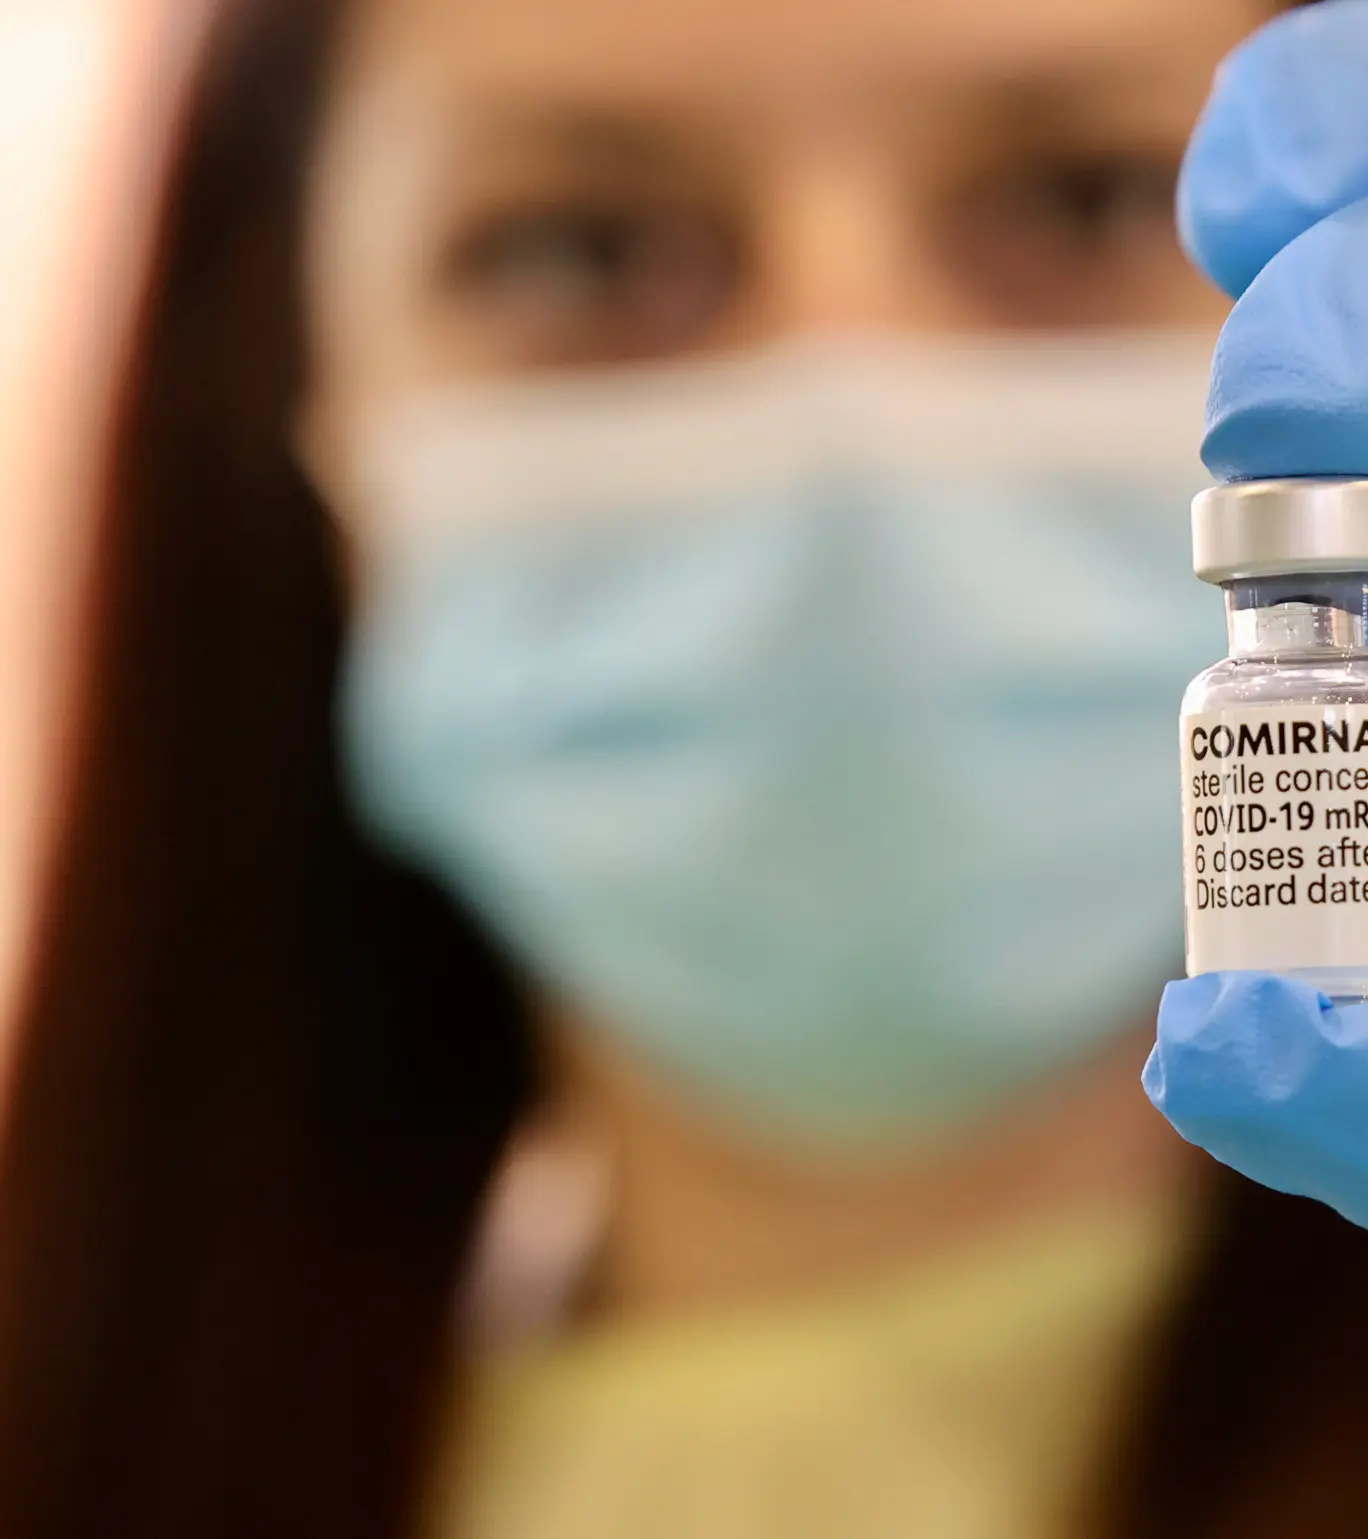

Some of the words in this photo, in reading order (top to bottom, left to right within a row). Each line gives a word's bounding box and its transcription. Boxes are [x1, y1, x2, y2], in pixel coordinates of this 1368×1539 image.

[1193, 763, 1265, 798] sterile
[1194, 800, 1315, 836] COVID-19
[1195, 843, 1206, 874] 6
[1213, 841, 1304, 873] doses
[1197, 874, 1296, 910] Discard
